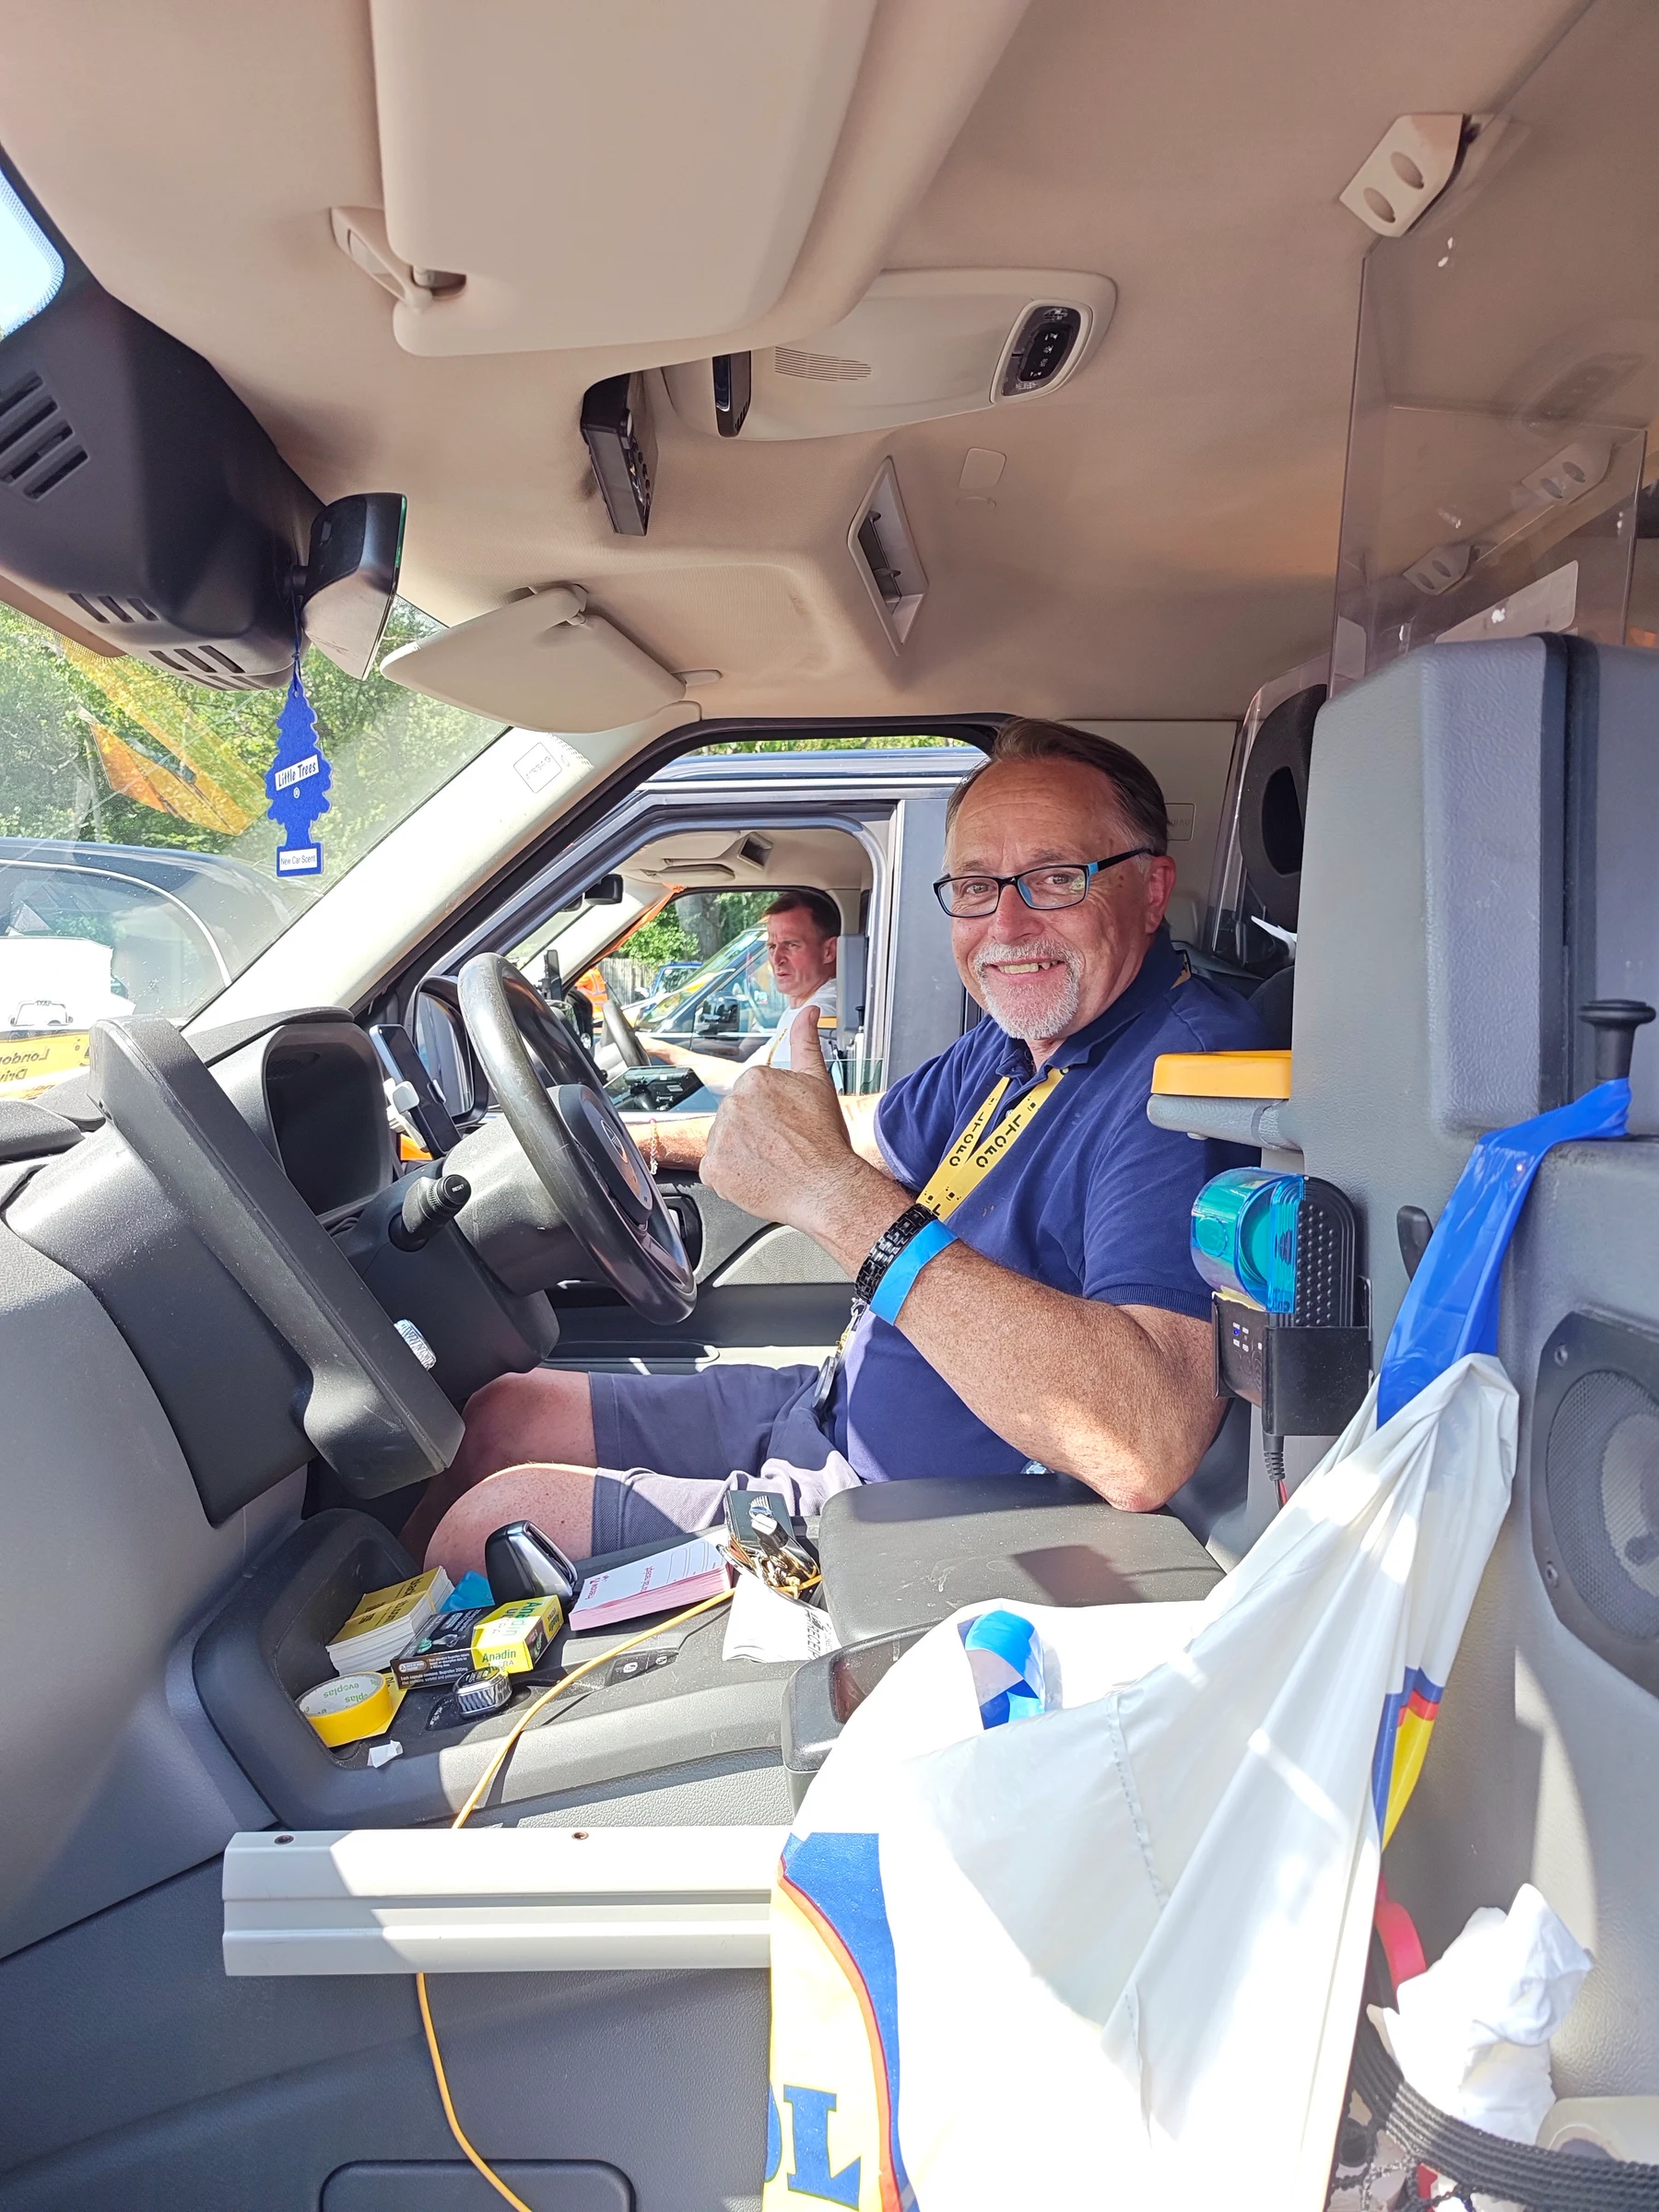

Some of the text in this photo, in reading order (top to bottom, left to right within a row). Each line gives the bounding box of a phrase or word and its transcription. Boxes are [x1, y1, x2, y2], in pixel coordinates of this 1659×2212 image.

[278, 761, 316, 787] Little Trees
[280, 854, 316, 865] New Car Scent
[948, 1111, 983, 1167] LTCFC
[975, 1113, 1022, 1168] LTCFC
[806, 1623, 822, 1661] RECEIP
[482, 1649, 516, 1663] Anadin
[324, 1682, 359, 1699] evoplas
